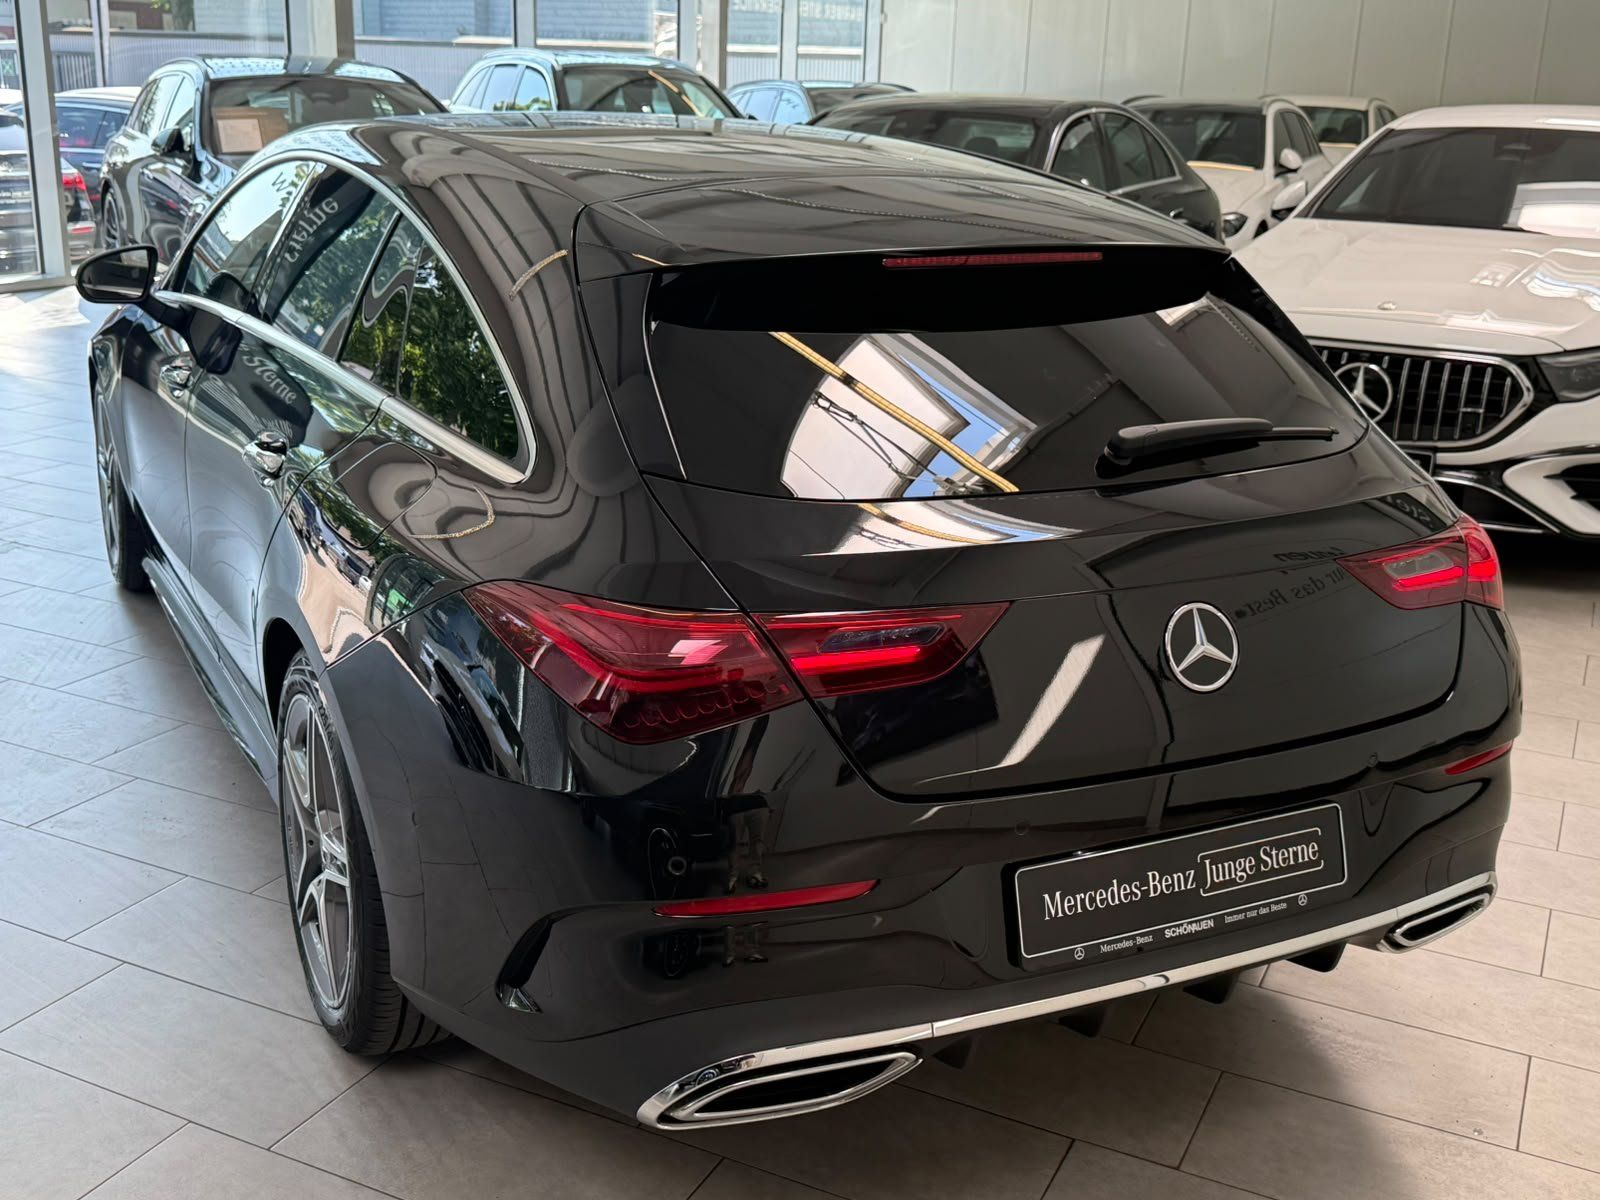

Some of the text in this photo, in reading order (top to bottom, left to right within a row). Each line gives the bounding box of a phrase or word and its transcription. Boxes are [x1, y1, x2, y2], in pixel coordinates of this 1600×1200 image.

[1043, 840, 1320, 920] Mercedes-Benz Junge Sterne
[1100, 934, 1154, 954] Mercedes-Benz
[1224, 911, 1245, 924] Immer
[1246, 910, 1258, 919] nur
[1258, 905, 1270, 915] das
[1270, 901, 1288, 914] Beste
